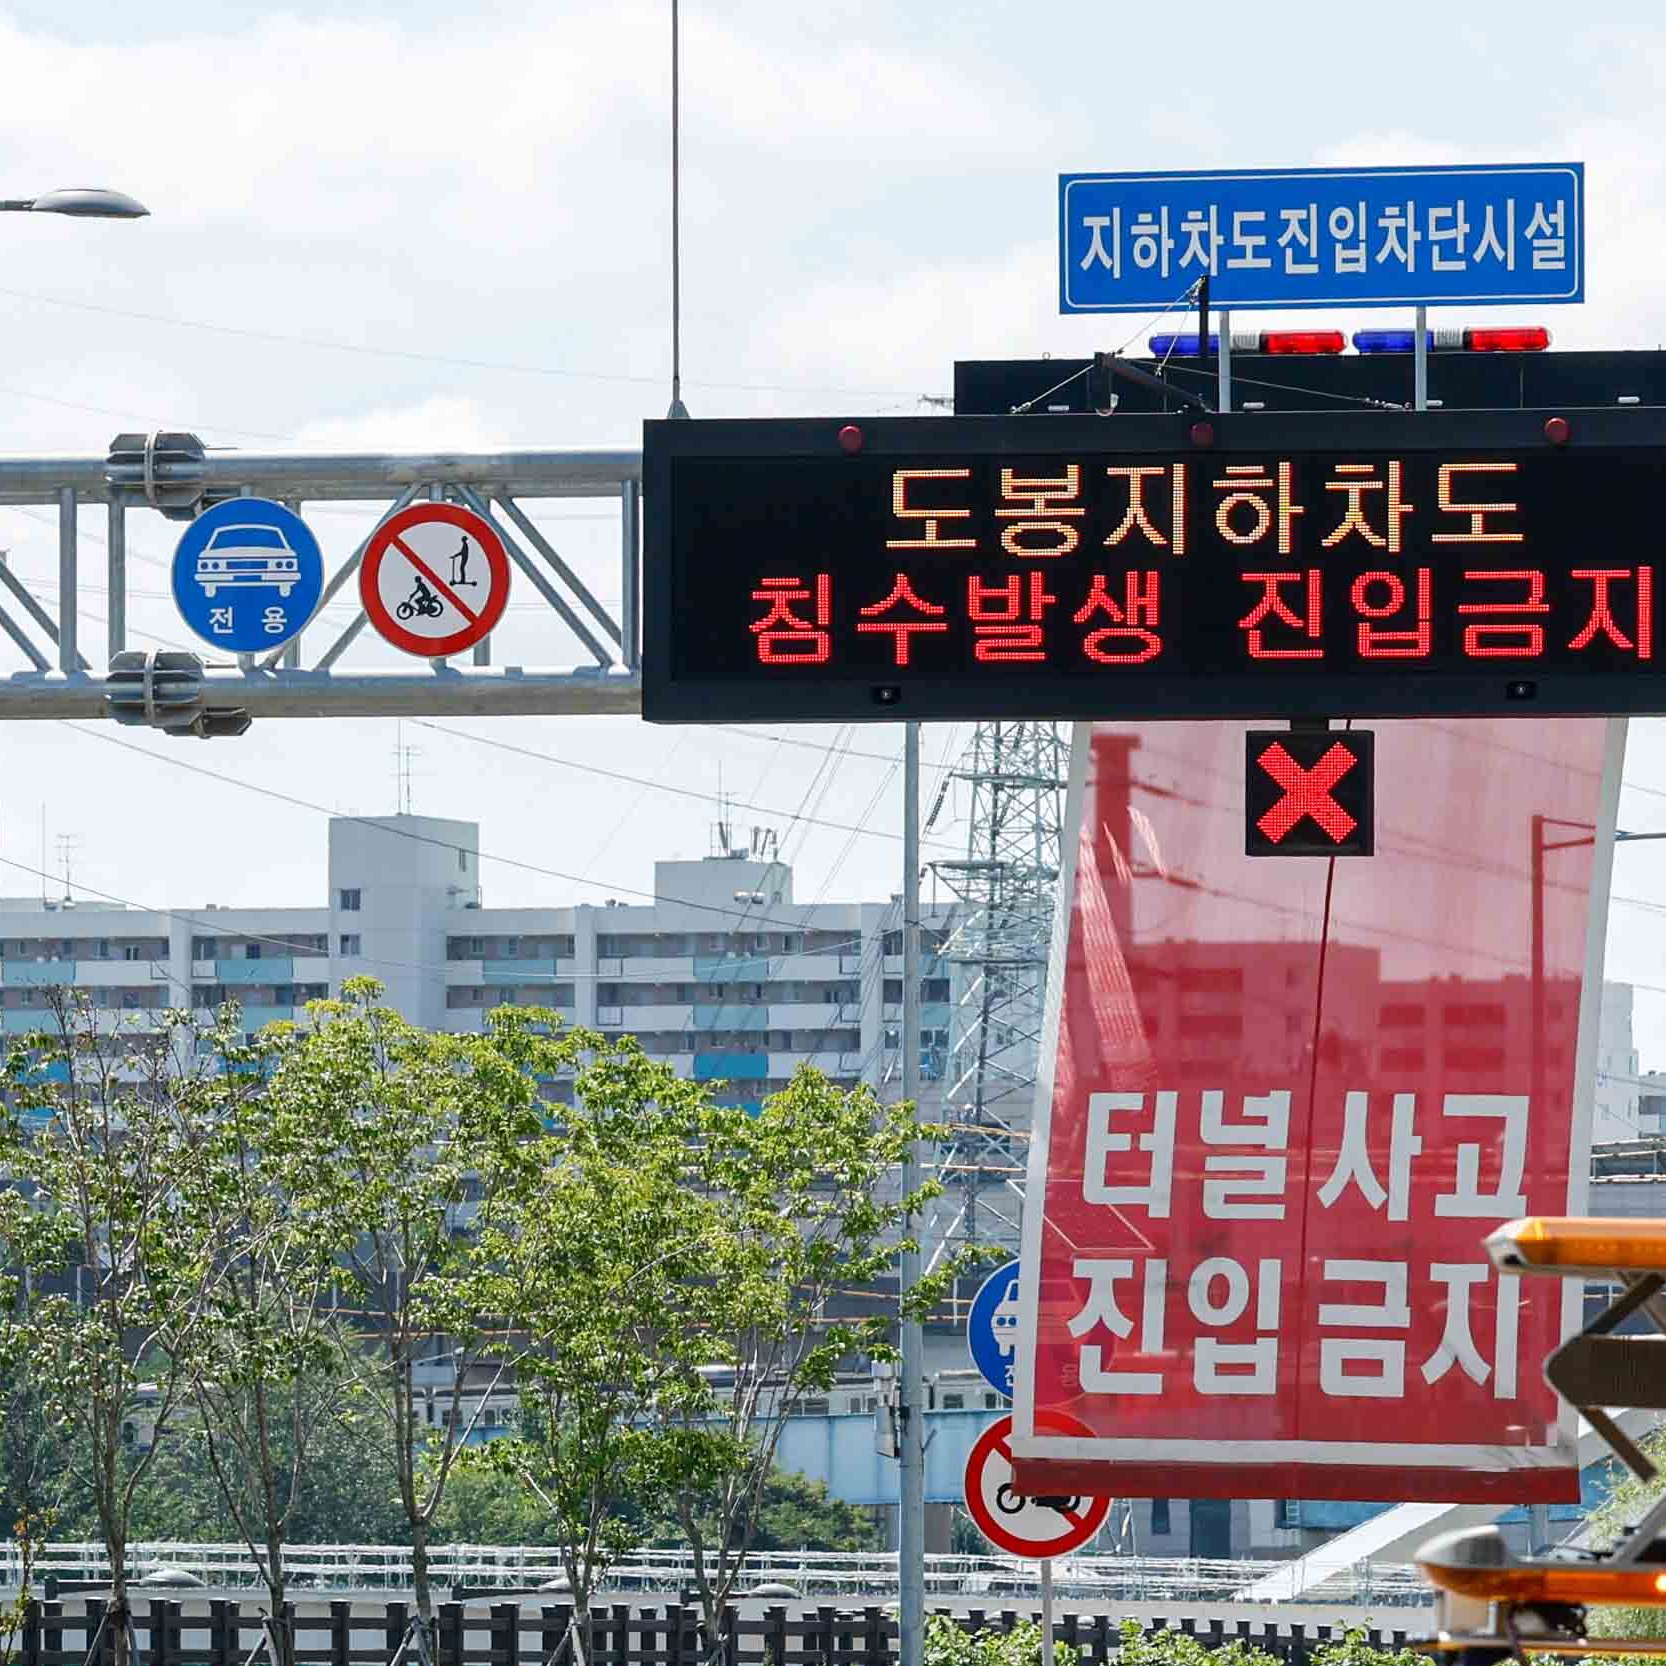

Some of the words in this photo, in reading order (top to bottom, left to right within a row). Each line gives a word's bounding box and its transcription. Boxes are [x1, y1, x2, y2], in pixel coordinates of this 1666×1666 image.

[1079, 198, 1568, 281] 지하차도진입차단시설
[884, 460, 1526, 557] 도봉지하차도
[747, 569, 1164, 666] 침수발생
[1237, 564, 1656, 661] 진입금지
